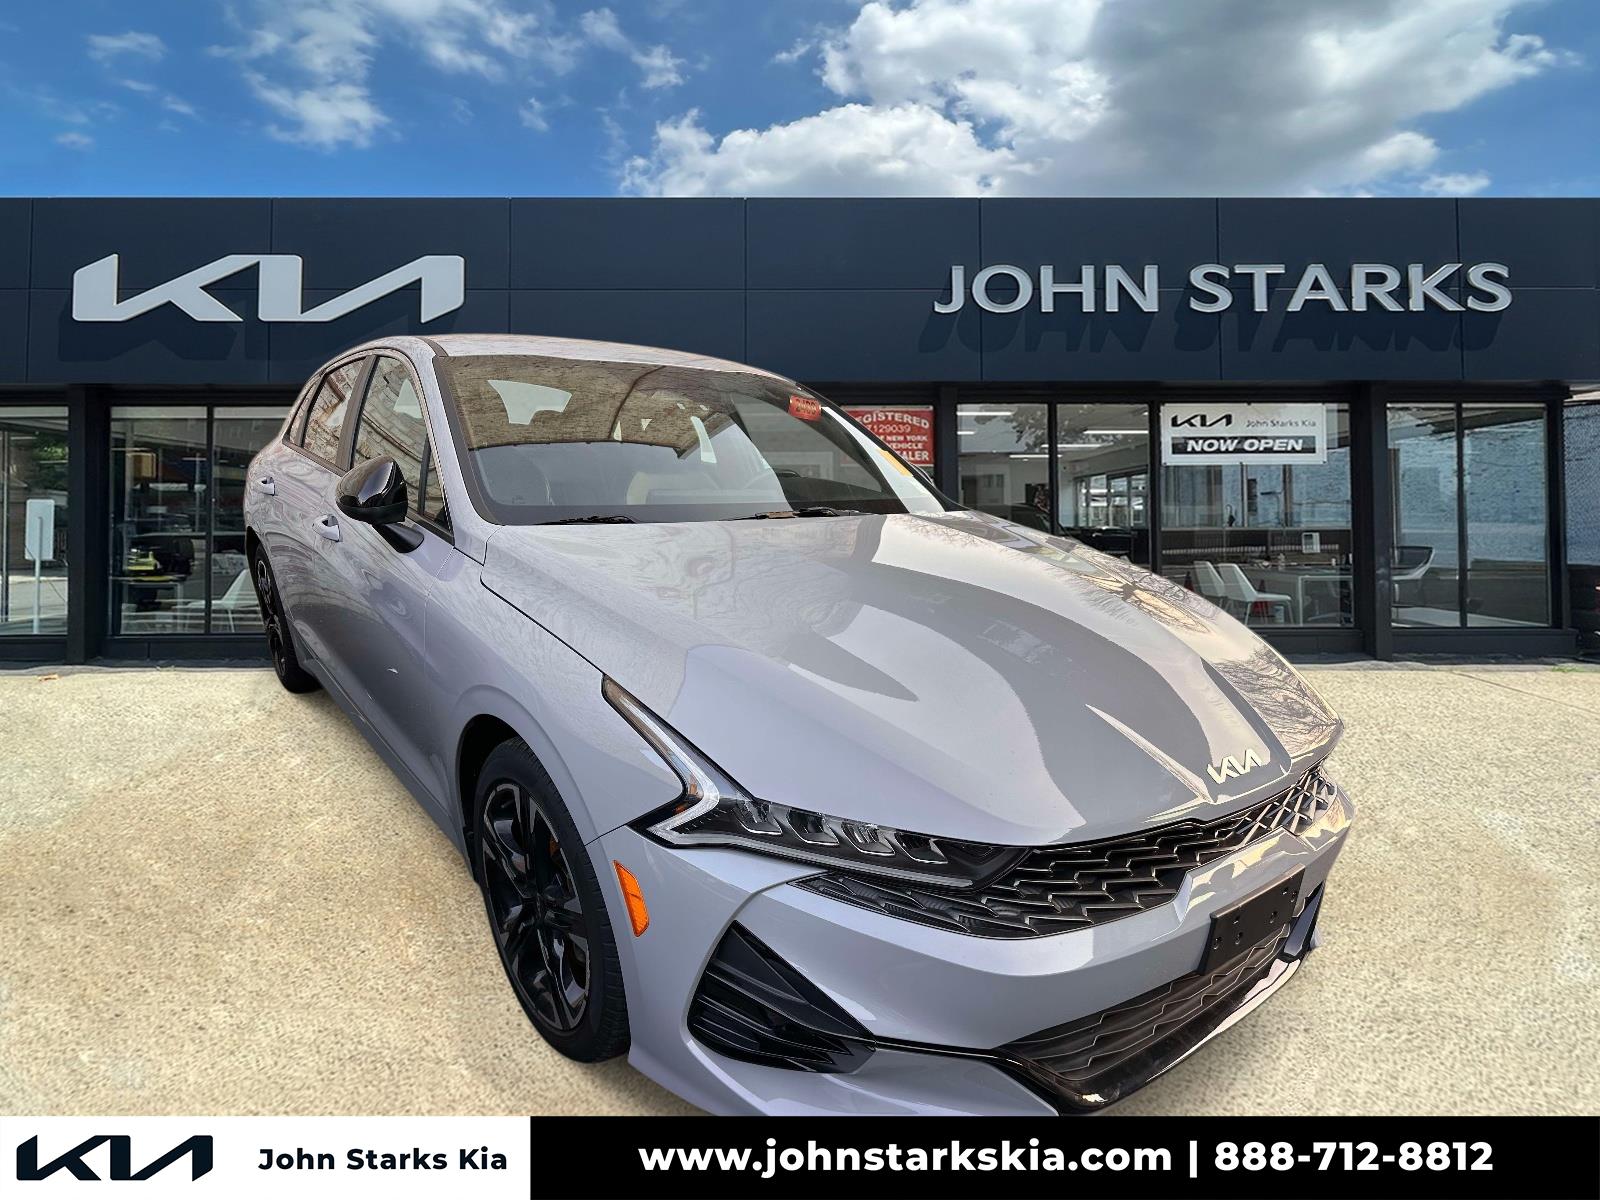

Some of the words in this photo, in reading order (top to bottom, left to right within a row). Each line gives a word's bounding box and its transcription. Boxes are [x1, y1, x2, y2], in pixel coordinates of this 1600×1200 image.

[933, 264, 1160, 315] JOHN
[1188, 262, 1513, 314] STARKS
[1246, 419, 1268, 428] John
[1270, 419, 1299, 427] Starks
[1301, 419, 1316, 427] Kia
[1186, 439, 1236, 452] NOW
[1243, 439, 1303, 451] OPEN
